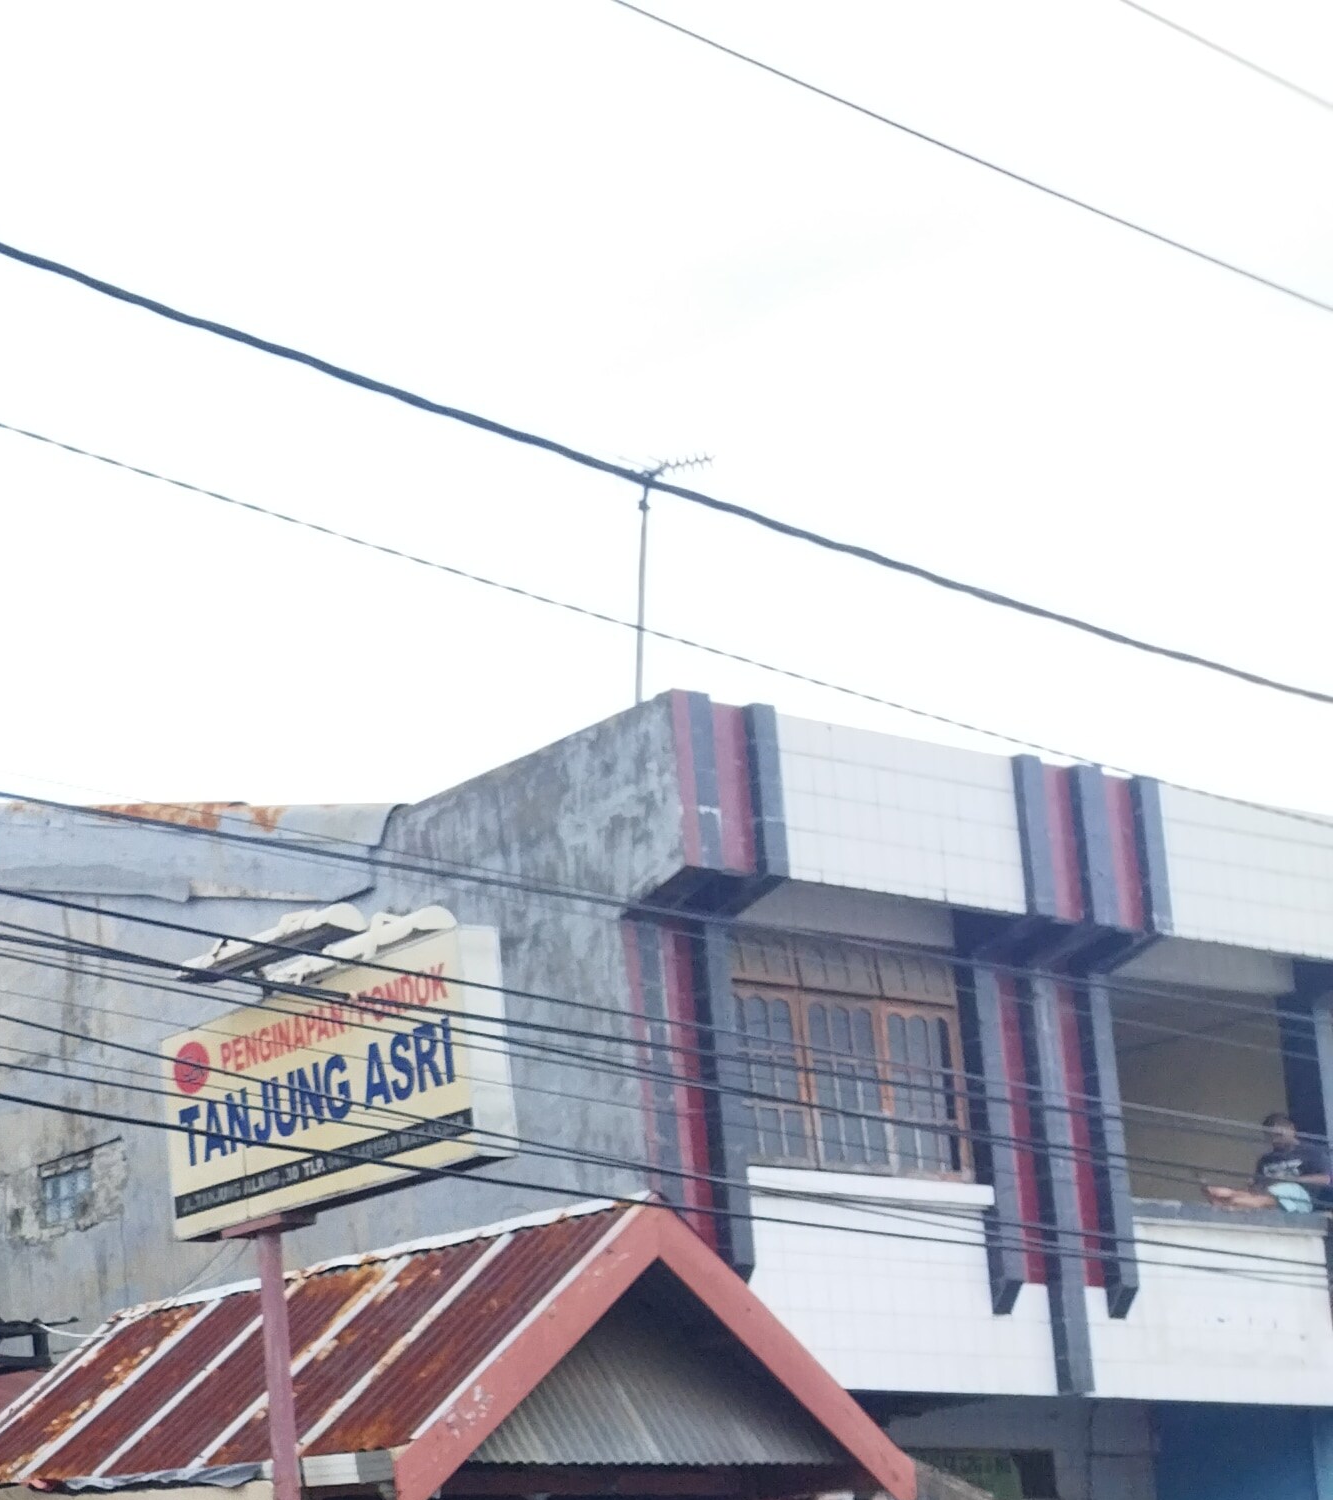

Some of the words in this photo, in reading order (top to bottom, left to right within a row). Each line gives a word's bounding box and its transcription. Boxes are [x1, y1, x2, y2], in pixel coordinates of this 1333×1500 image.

[179, 1055, 351, 1166] TANJUNG
[365, 1016, 456, 1110] ASRI
[220, 1003, 345, 1071] PENGINAPAN
